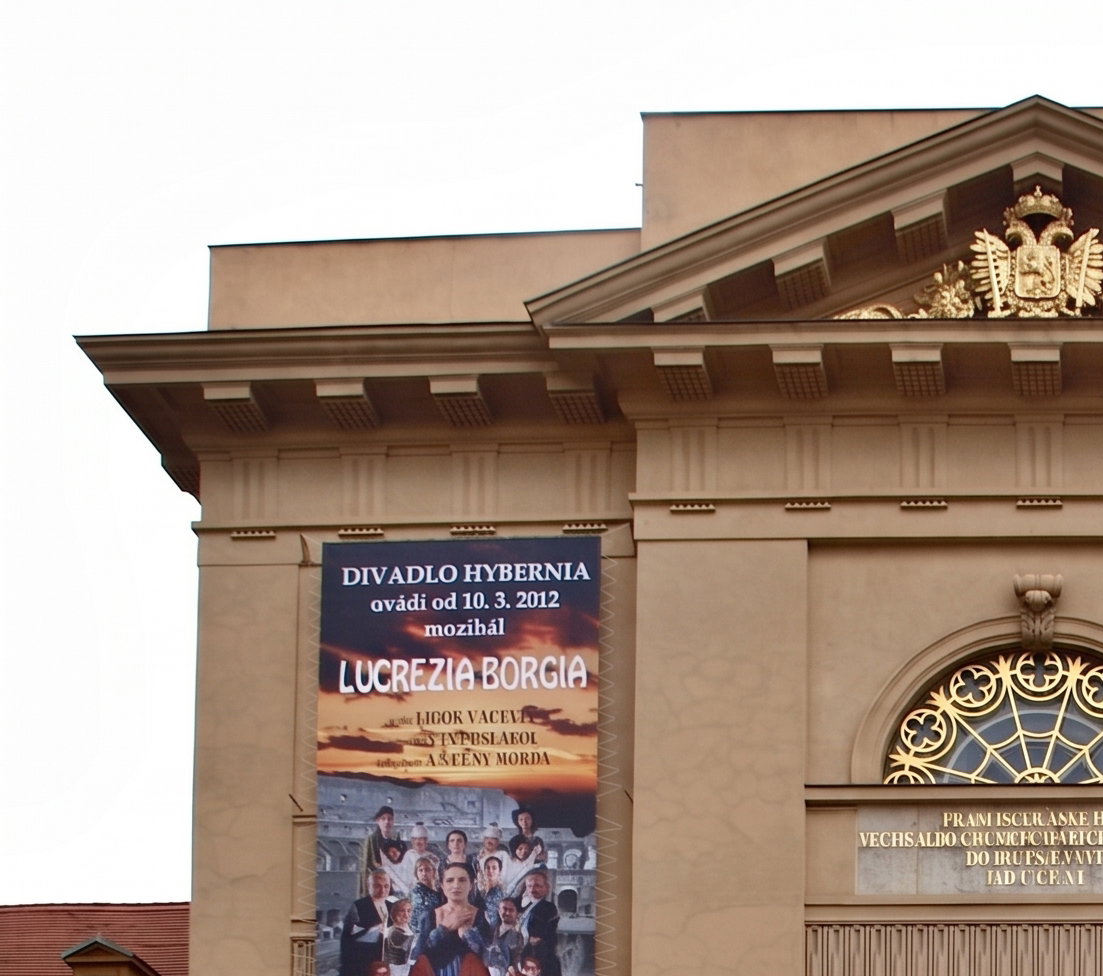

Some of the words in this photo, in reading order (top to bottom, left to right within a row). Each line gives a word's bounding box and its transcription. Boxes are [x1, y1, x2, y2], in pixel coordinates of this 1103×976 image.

[342, 564, 458, 586] DIVADLO
[463, 562, 591, 583] HYBERNIA
[432, 594, 458, 610] od
[462, 592, 489, 610] 10.
[495, 592, 511, 610] 3.
[516, 591, 560, 608] 2012
[339, 657, 474, 694] LUCREZIA
[482, 654, 588, 691] BORGIA
